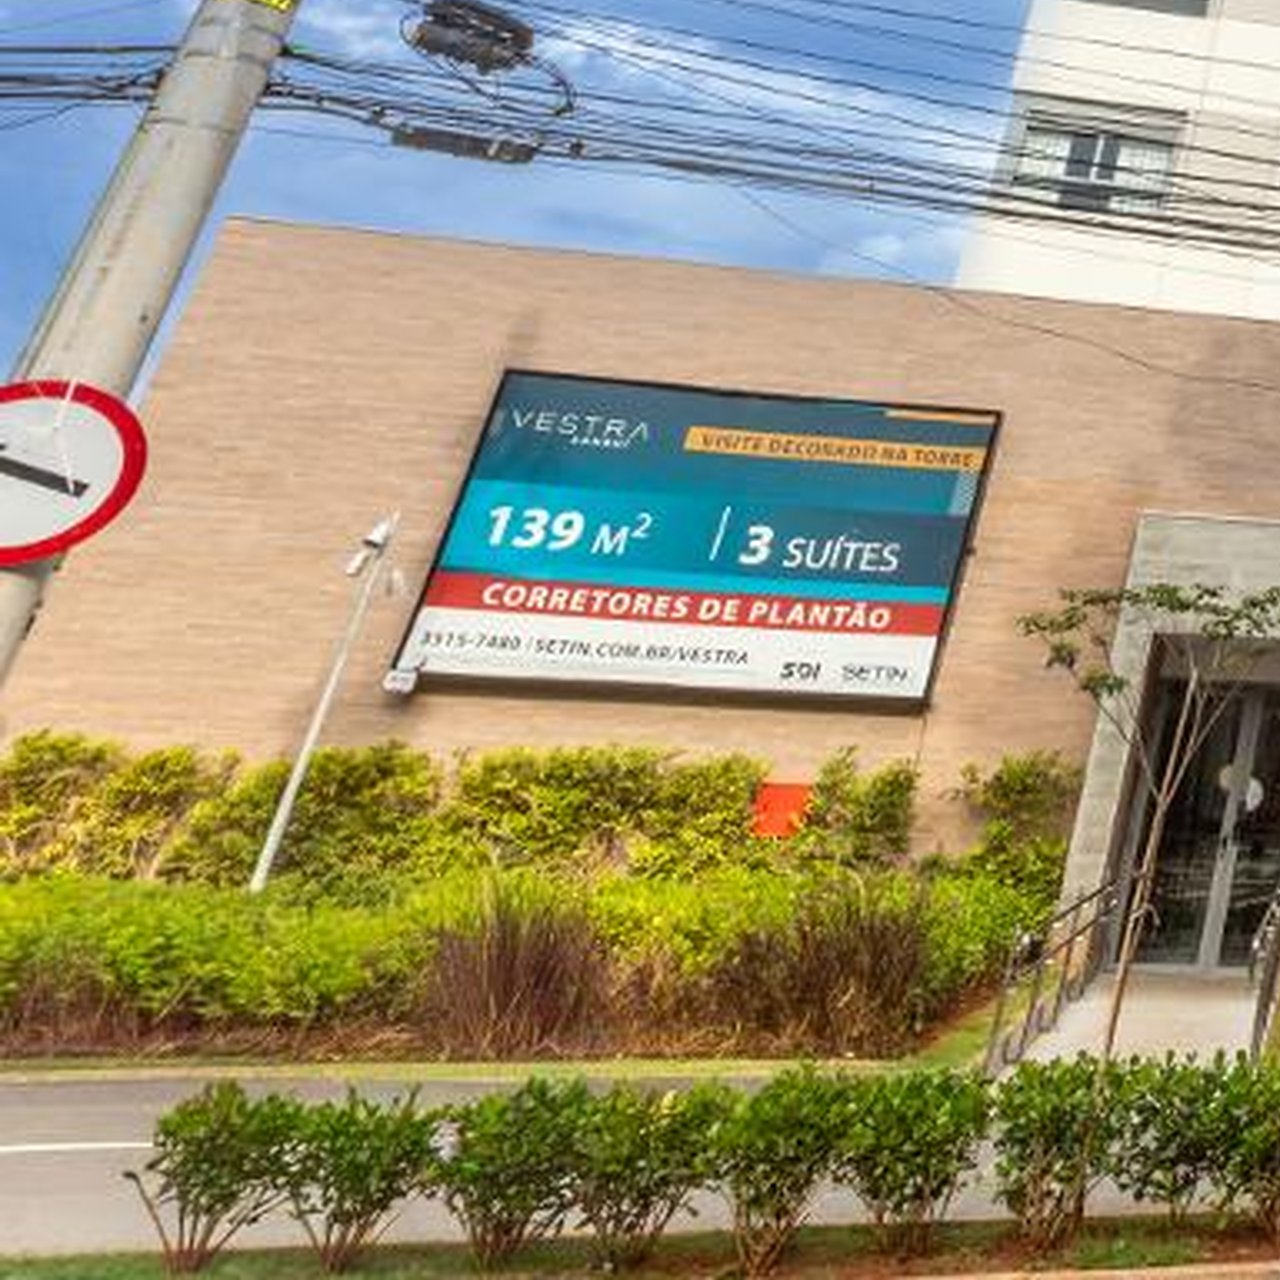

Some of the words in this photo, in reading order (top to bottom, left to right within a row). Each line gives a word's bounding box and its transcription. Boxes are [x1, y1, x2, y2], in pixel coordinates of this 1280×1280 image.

[511, 409, 648, 440] VESTRA
[702, 432, 761, 451] VISITE
[487, 505, 585, 551] 139
[739, 525, 774, 566] 3
[783, 536, 900, 572] SUÍTES
[482, 582, 691, 620] CORRETORES
[697, 598, 739, 623] DE
[747, 601, 891, 629] PLANTÃO
